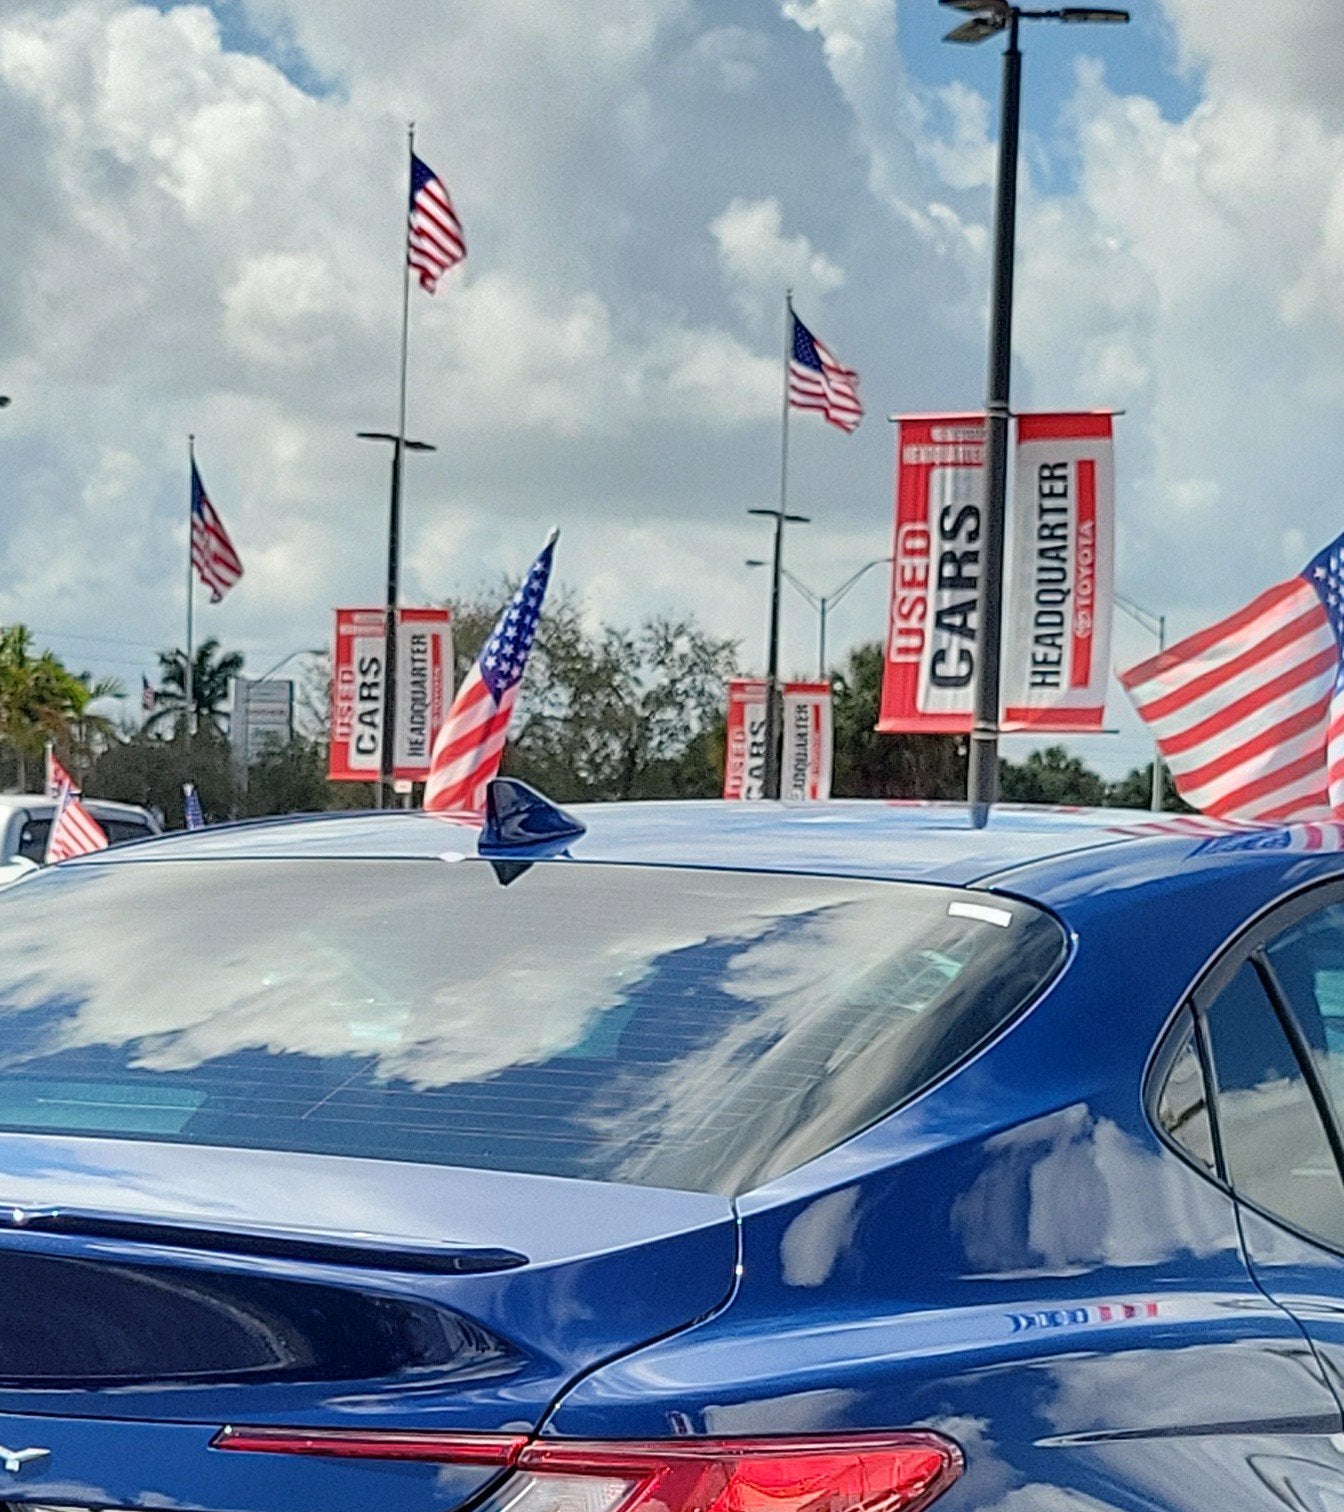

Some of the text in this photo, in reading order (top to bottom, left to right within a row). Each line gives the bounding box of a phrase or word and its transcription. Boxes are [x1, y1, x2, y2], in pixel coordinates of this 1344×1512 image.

[895, 526, 931, 661] USED
[930, 503, 981, 689] CARS
[1029, 460, 1070, 691] HEADQUARTER
[1075, 519, 1096, 608] TOYOTA
[336, 670, 355, 738] USED
[356, 655, 382, 755] CARS
[408, 633, 429, 758] HEADQUARTER
